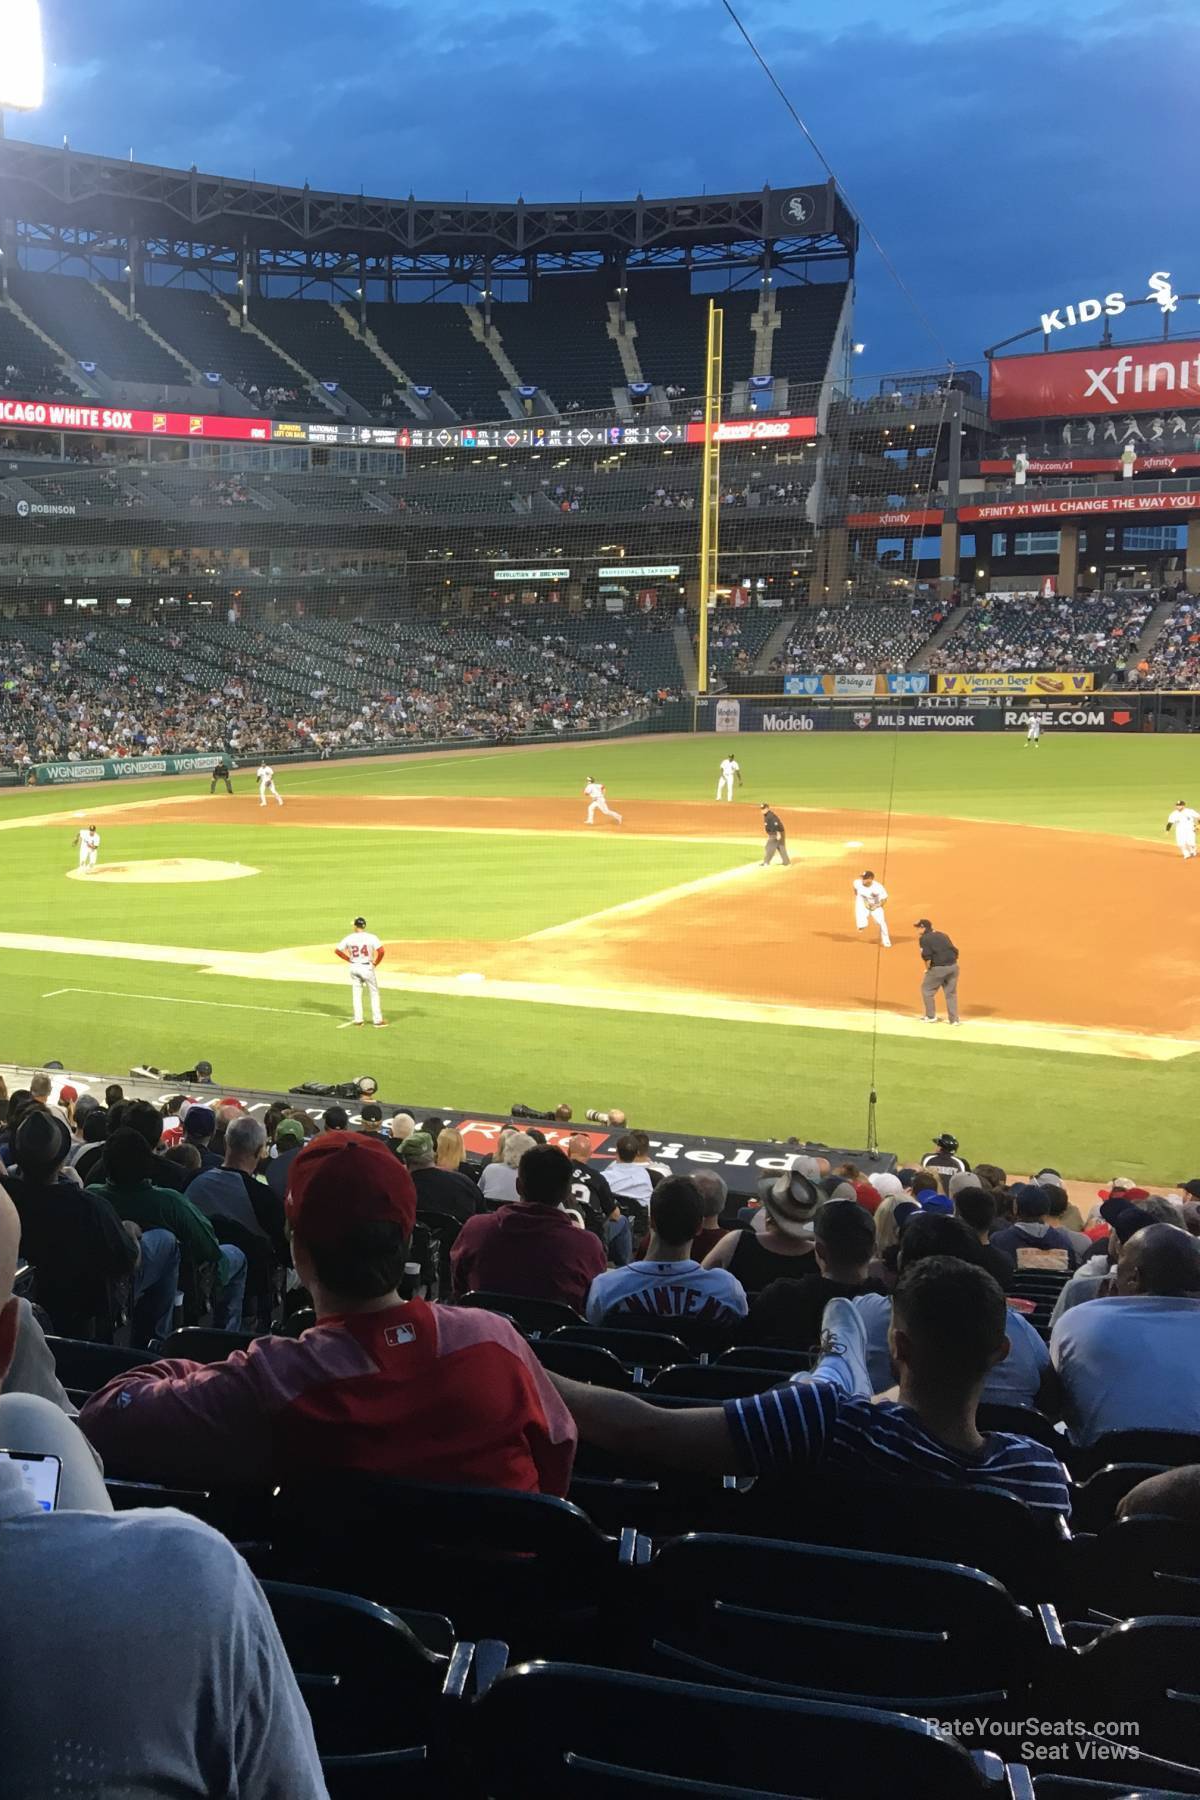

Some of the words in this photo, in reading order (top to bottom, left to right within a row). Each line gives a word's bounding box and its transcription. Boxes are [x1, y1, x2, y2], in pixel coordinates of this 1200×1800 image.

[1040, 292, 1126, 334] KIDS
[49, 406, 99, 427] WHITE
[102, 410, 133, 430] SOX
[308, 425, 338, 434] NATIONALS
[624, 428, 639, 436] CHC
[549, 438, 562, 446] ATL
[1143, 457, 1175, 471] xfinity
[30, 505, 76, 515] ROBINSON
[978, 505, 1015, 518] XFINITY
[1017, 504, 1031, 516] X1
[1031, 502, 1058, 516] WILL
[1059, 499, 1110, 513] CHANGE
[1112, 497, 1137, 511] THE
[1138, 496, 1167, 510] WAY
[1168, 494, 1197, 508] YOU
[879, 511, 911, 528] xfinity
[836, 675, 864, 688] Bring
[962, 674, 1005, 687] Vienna
[1007, 674, 1034, 686] Beef
[762, 713, 814, 731] Modelo
[877, 715, 906, 727] MLB
[908, 714, 976, 727] NETWORK
[113, 761, 139, 774] WGN
[139, 761, 165, 772] SPORTS
[174, 758, 198, 771] WGN
[47, 766, 75, 779] WGN
[76, 767, 103, 778] SPORTS
[351, 944, 370, 958] 24
[608, 1140, 803, 1172] ield
